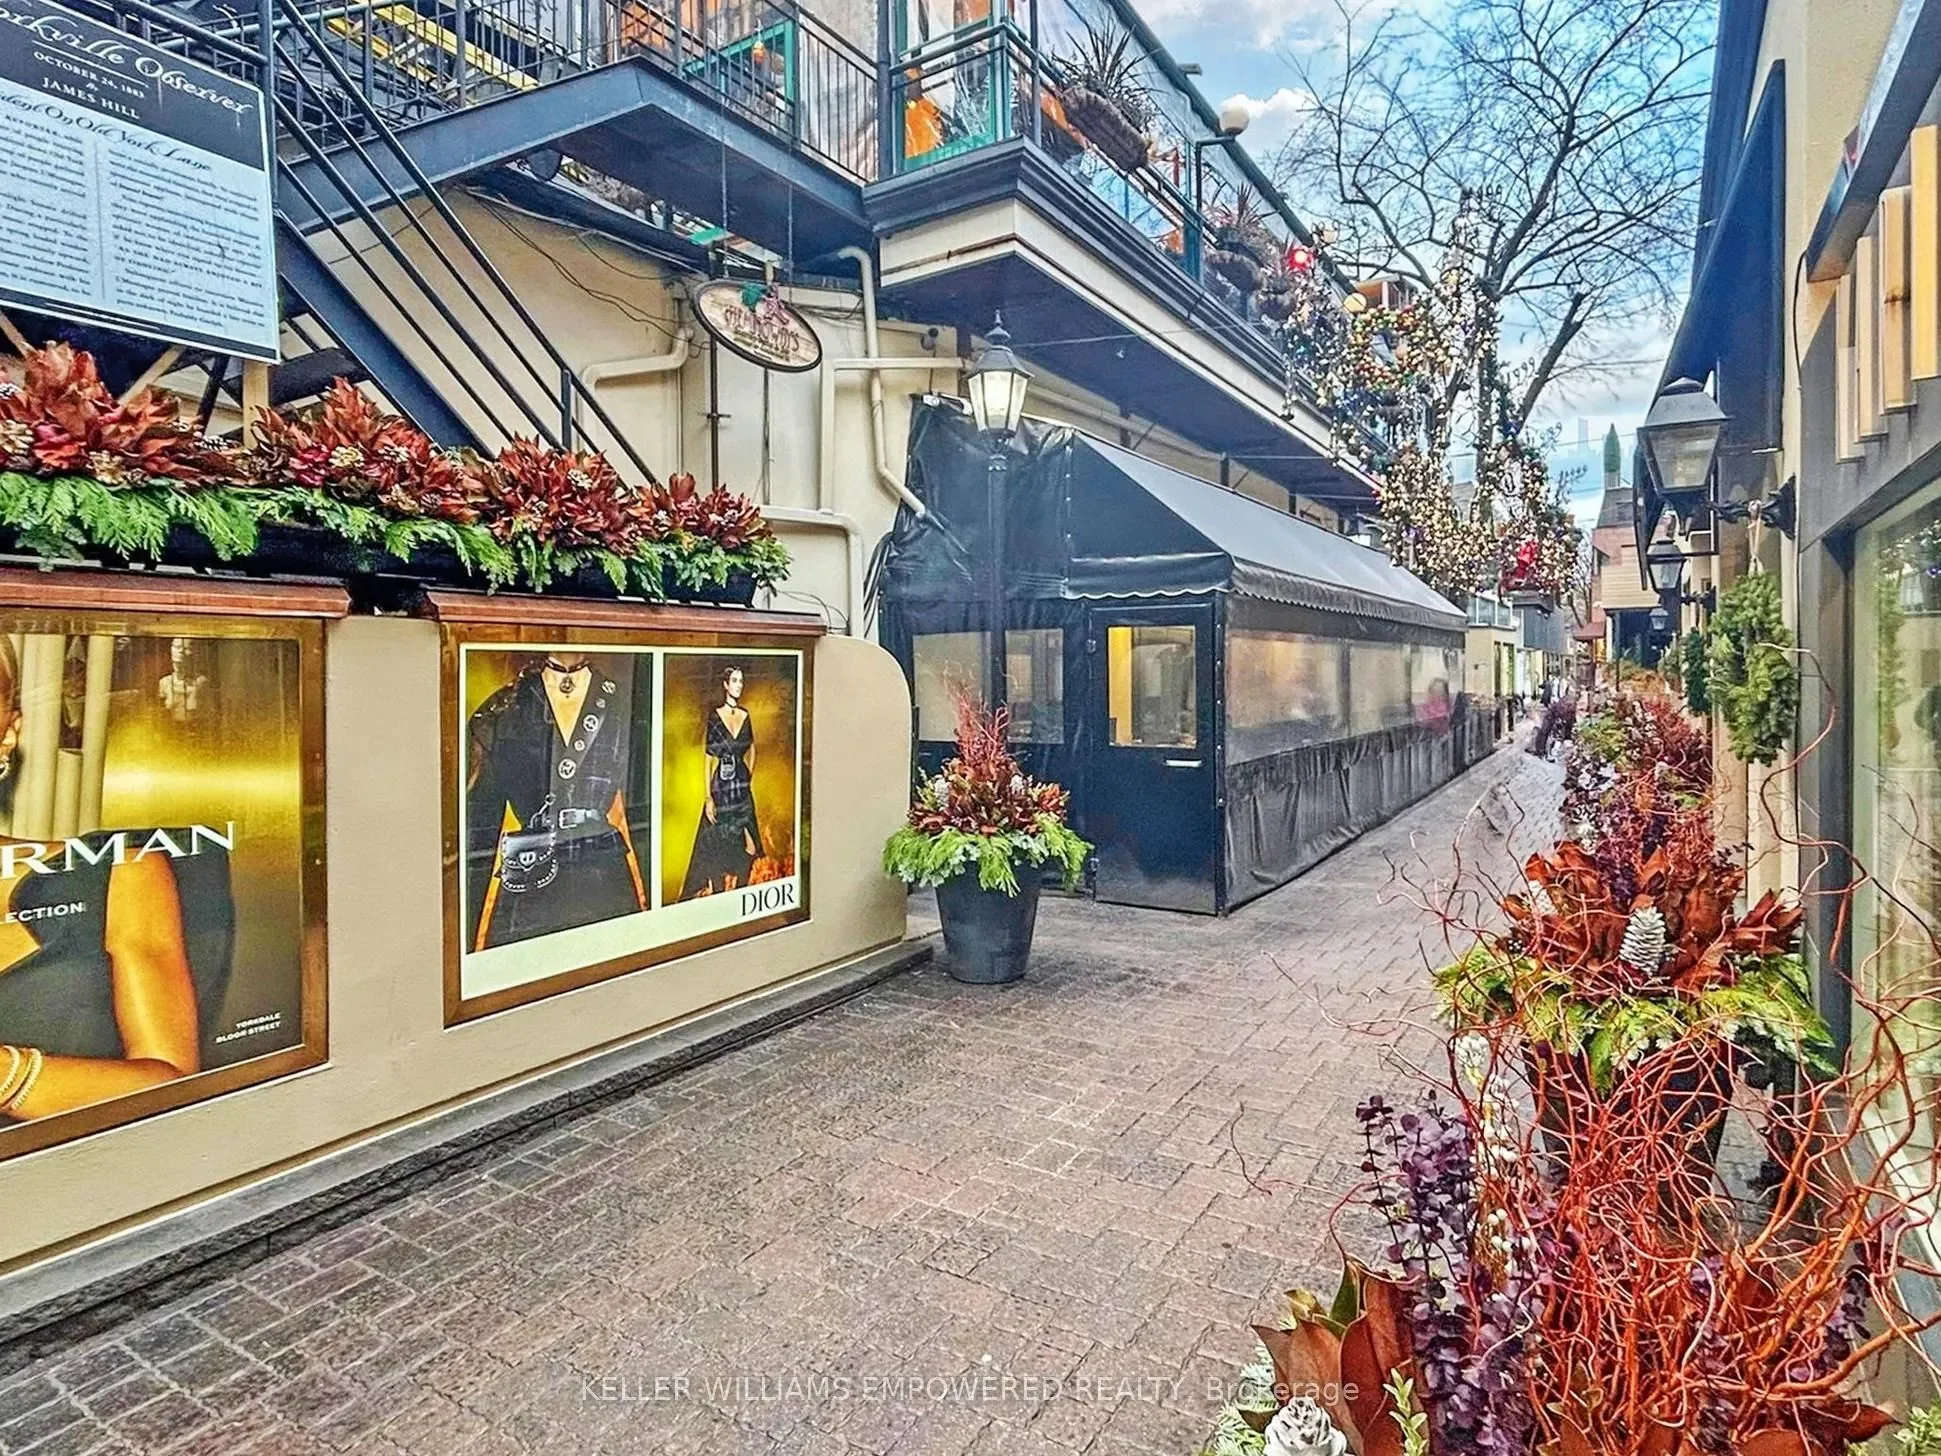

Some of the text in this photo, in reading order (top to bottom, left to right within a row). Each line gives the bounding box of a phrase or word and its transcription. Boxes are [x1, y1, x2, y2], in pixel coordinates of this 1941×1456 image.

[34, 51, 98, 81] OCTOBER
[42, 76, 140, 119] JAMES HILL
[135, 56, 254, 114] Observer
[5, 901, 84, 923] ECTION
[741, 883, 795, 917] DIOR
[215, 1021, 281, 1044] BLOOR STREET
